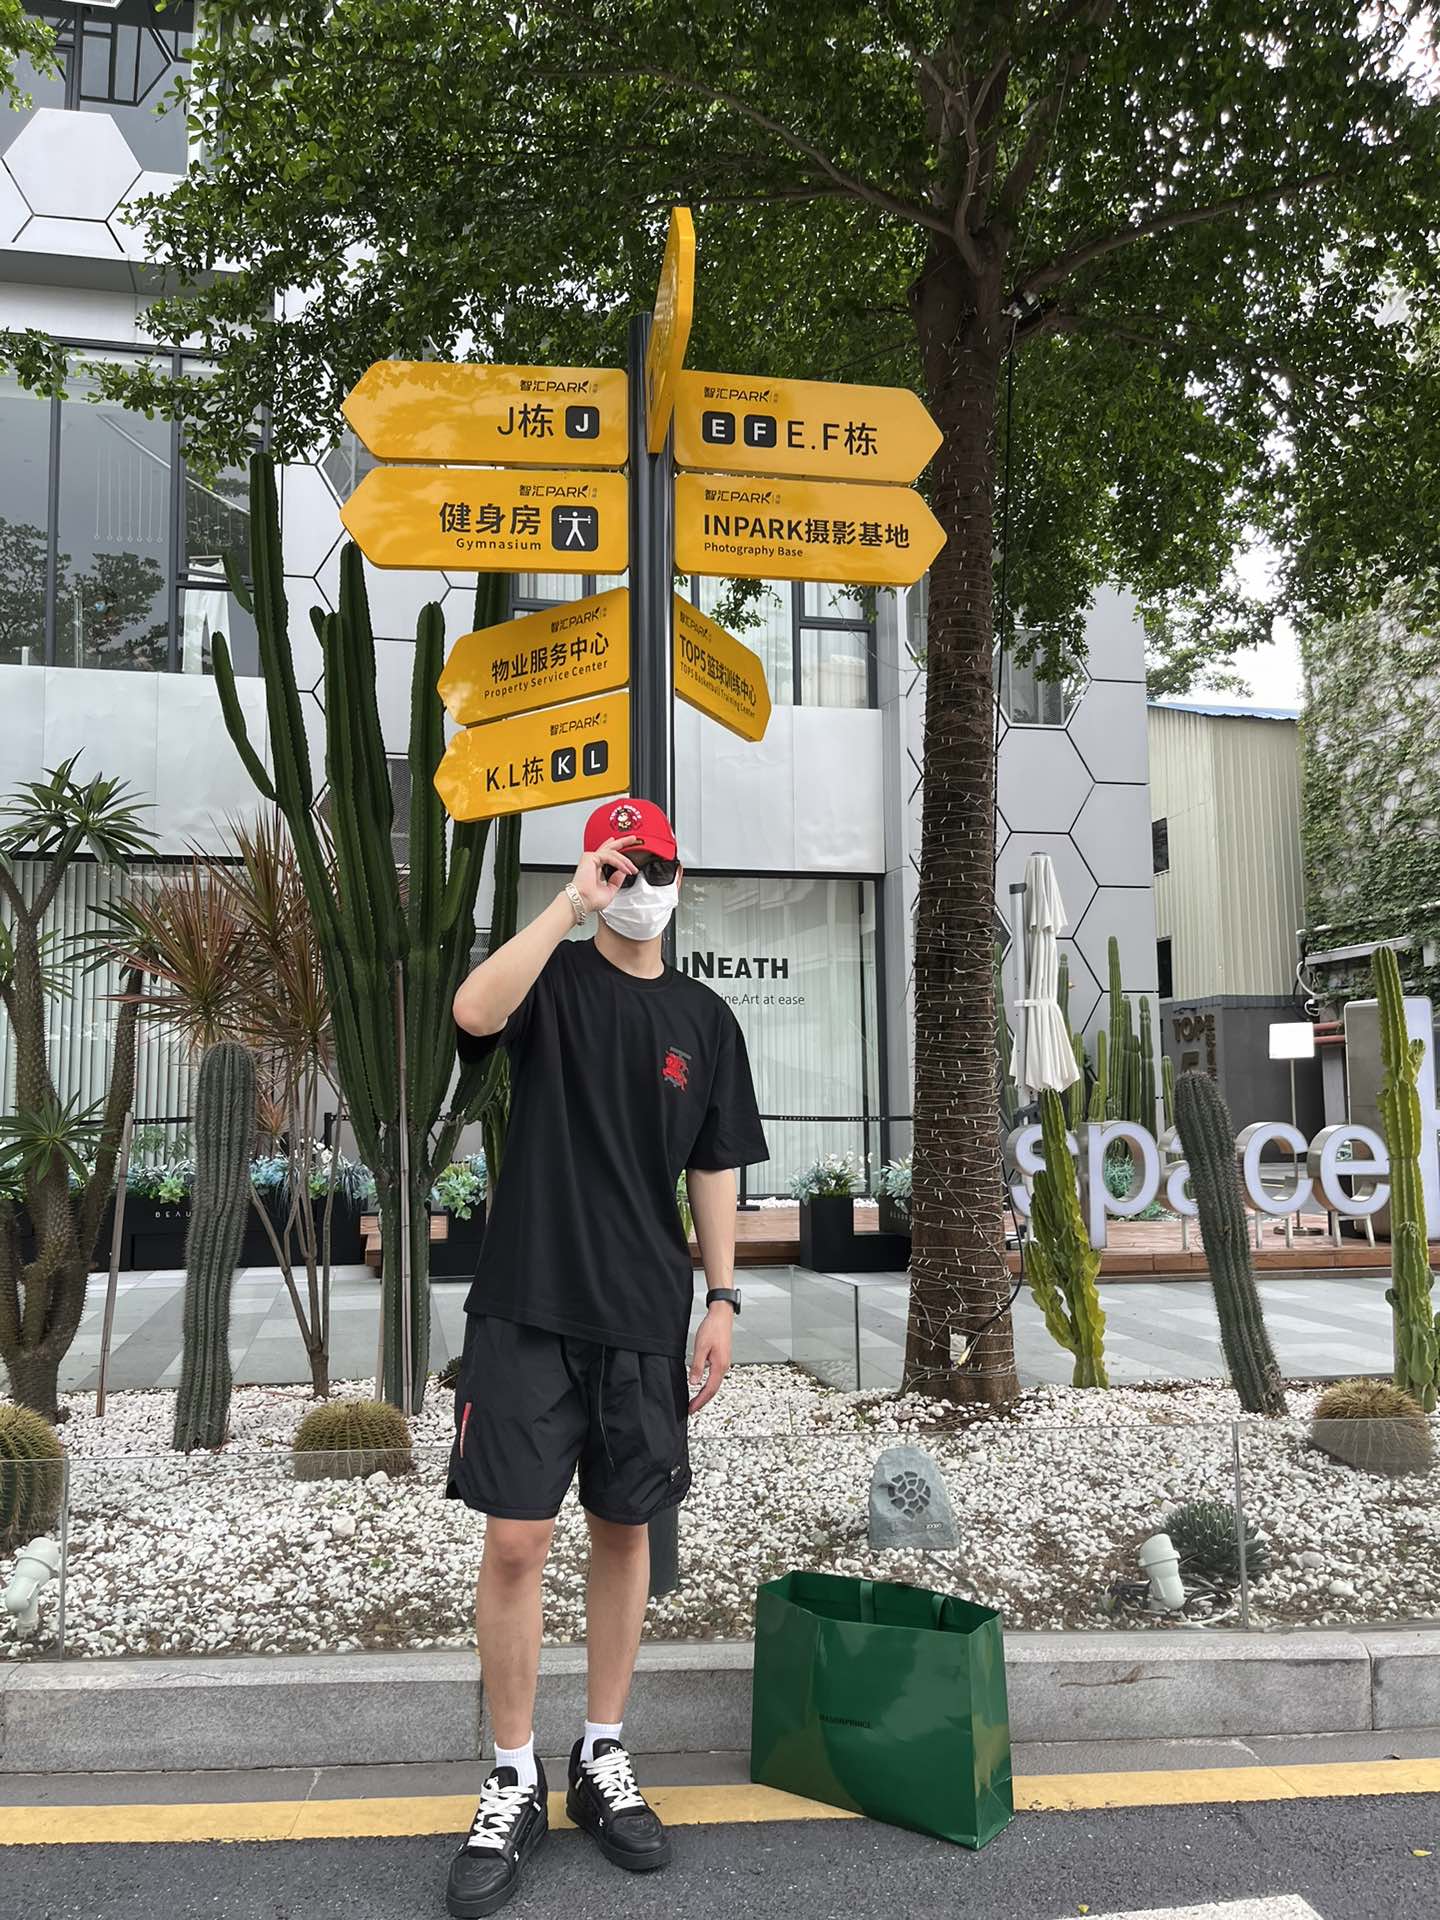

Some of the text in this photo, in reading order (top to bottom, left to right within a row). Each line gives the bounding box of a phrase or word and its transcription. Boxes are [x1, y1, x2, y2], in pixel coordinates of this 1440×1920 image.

[497, 402, 589, 439] J栋 J
[711, 418, 878, 456] E F E.F栋
[438, 501, 541, 536] 健身房
[703, 513, 911, 550] INPARK摄影基地
[456, 537, 542, 551] Gymnasium
[704, 541, 804, 558] Photography Base
[491, 631, 609, 684] 物业服务中心
[484, 660, 608, 700] Property Service Center
[486, 750, 601, 793] K.L栋 K L
[763, 995, 775, 1005] at
[778, 996, 806, 1005] ease
